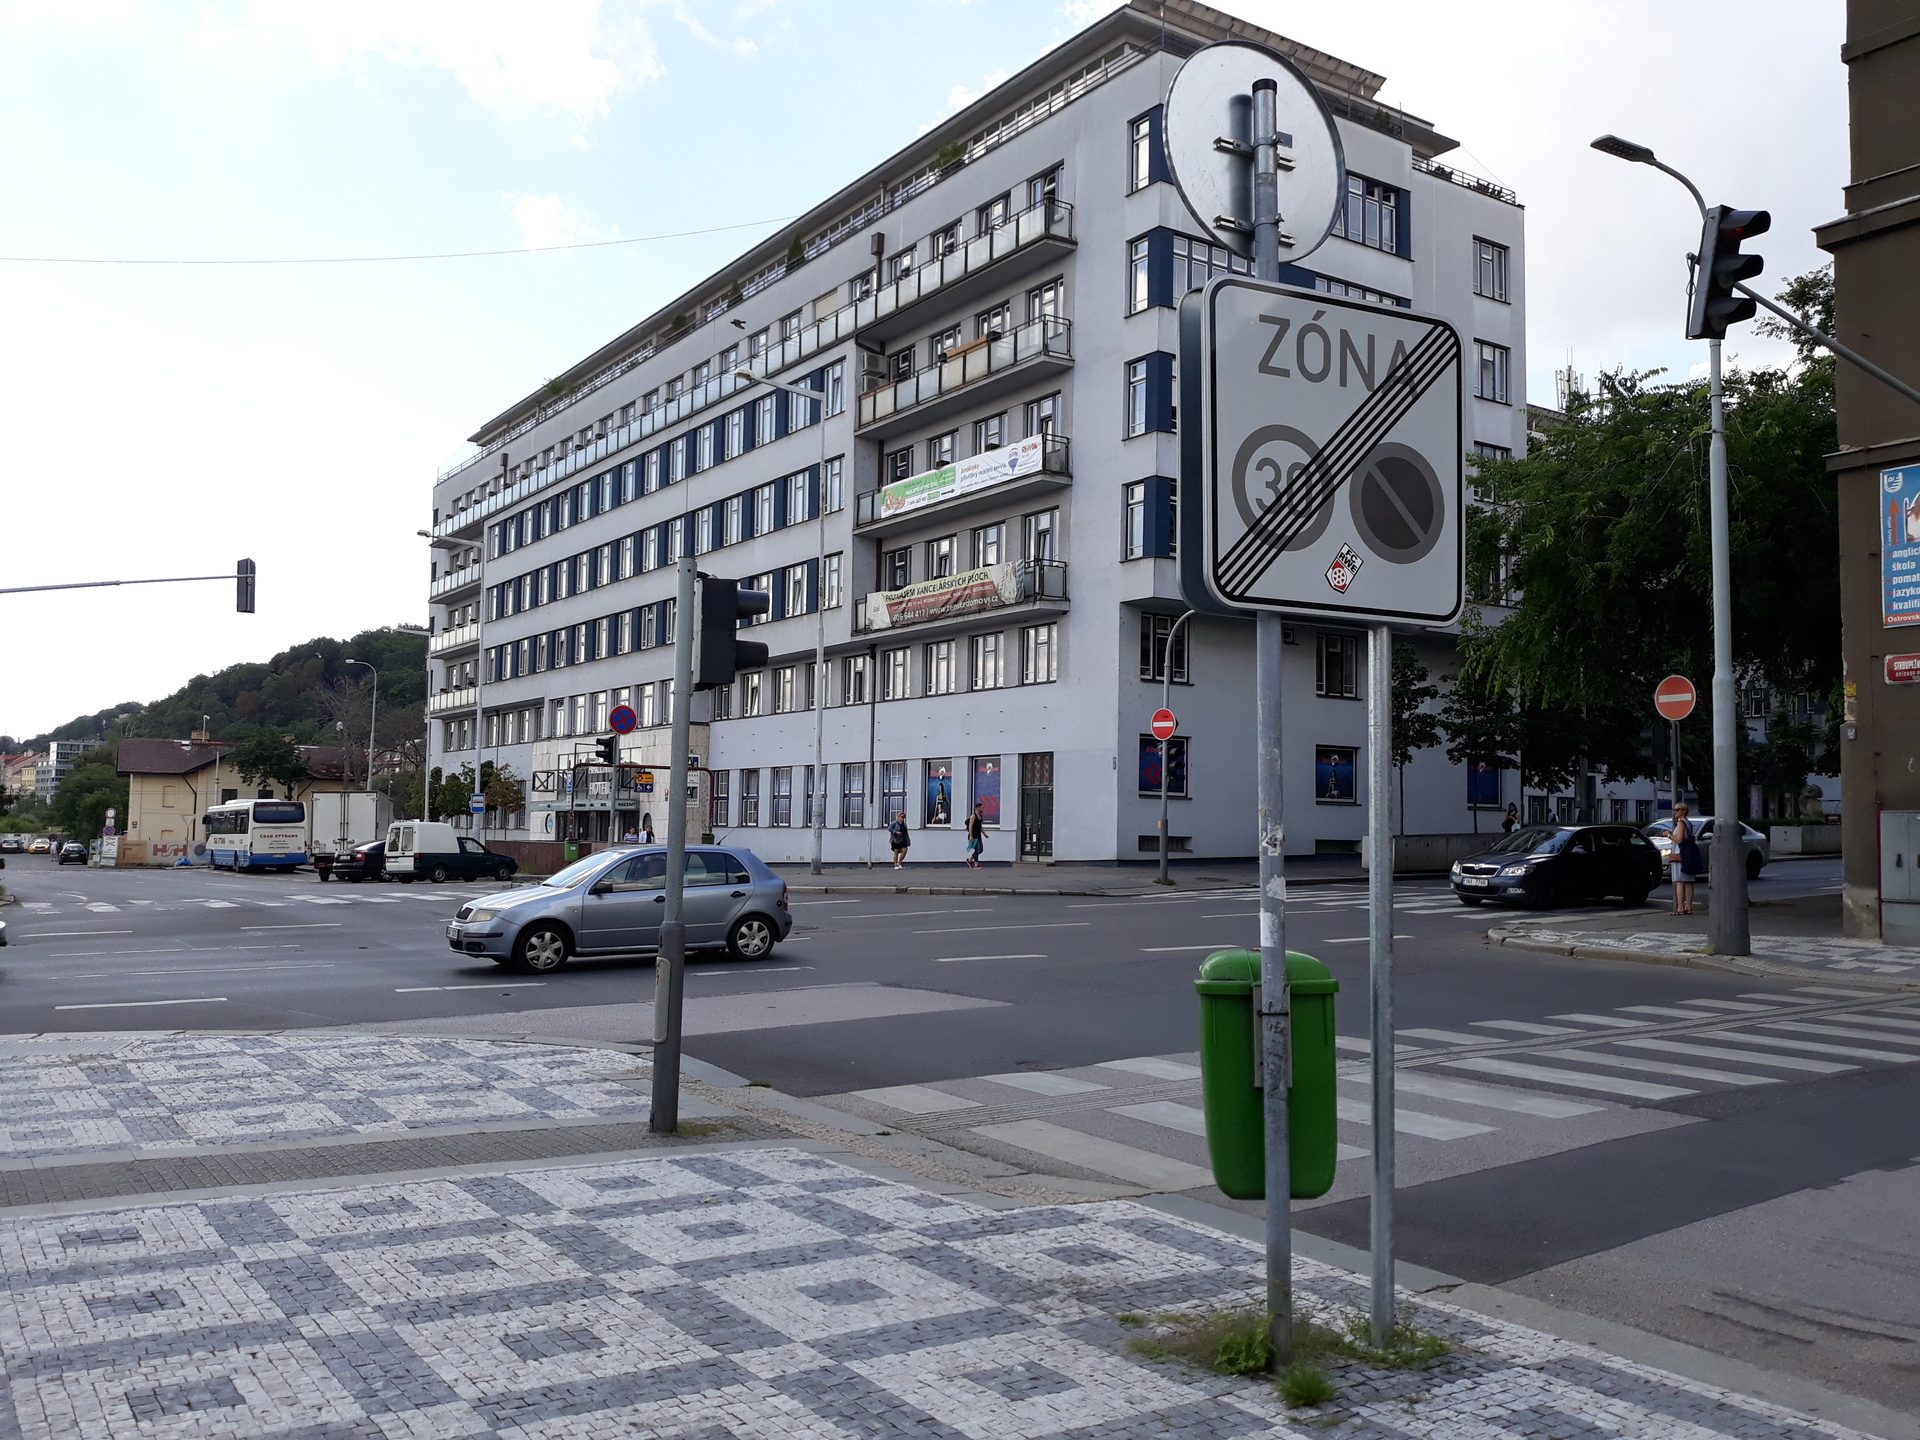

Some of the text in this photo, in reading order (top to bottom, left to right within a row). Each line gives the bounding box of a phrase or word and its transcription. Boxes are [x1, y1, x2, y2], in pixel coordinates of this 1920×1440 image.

[1258, 309, 1419, 400] ZÓNA
[1254, 457, 1313, 519] 30
[1338, 552, 1358, 573] RWE
[1345, 549, 1358, 564] FC
[1892, 561, 1916, 572] škola
[967, 571, 989, 585] PLOCH
[589, 782, 609, 795] HOTEL
